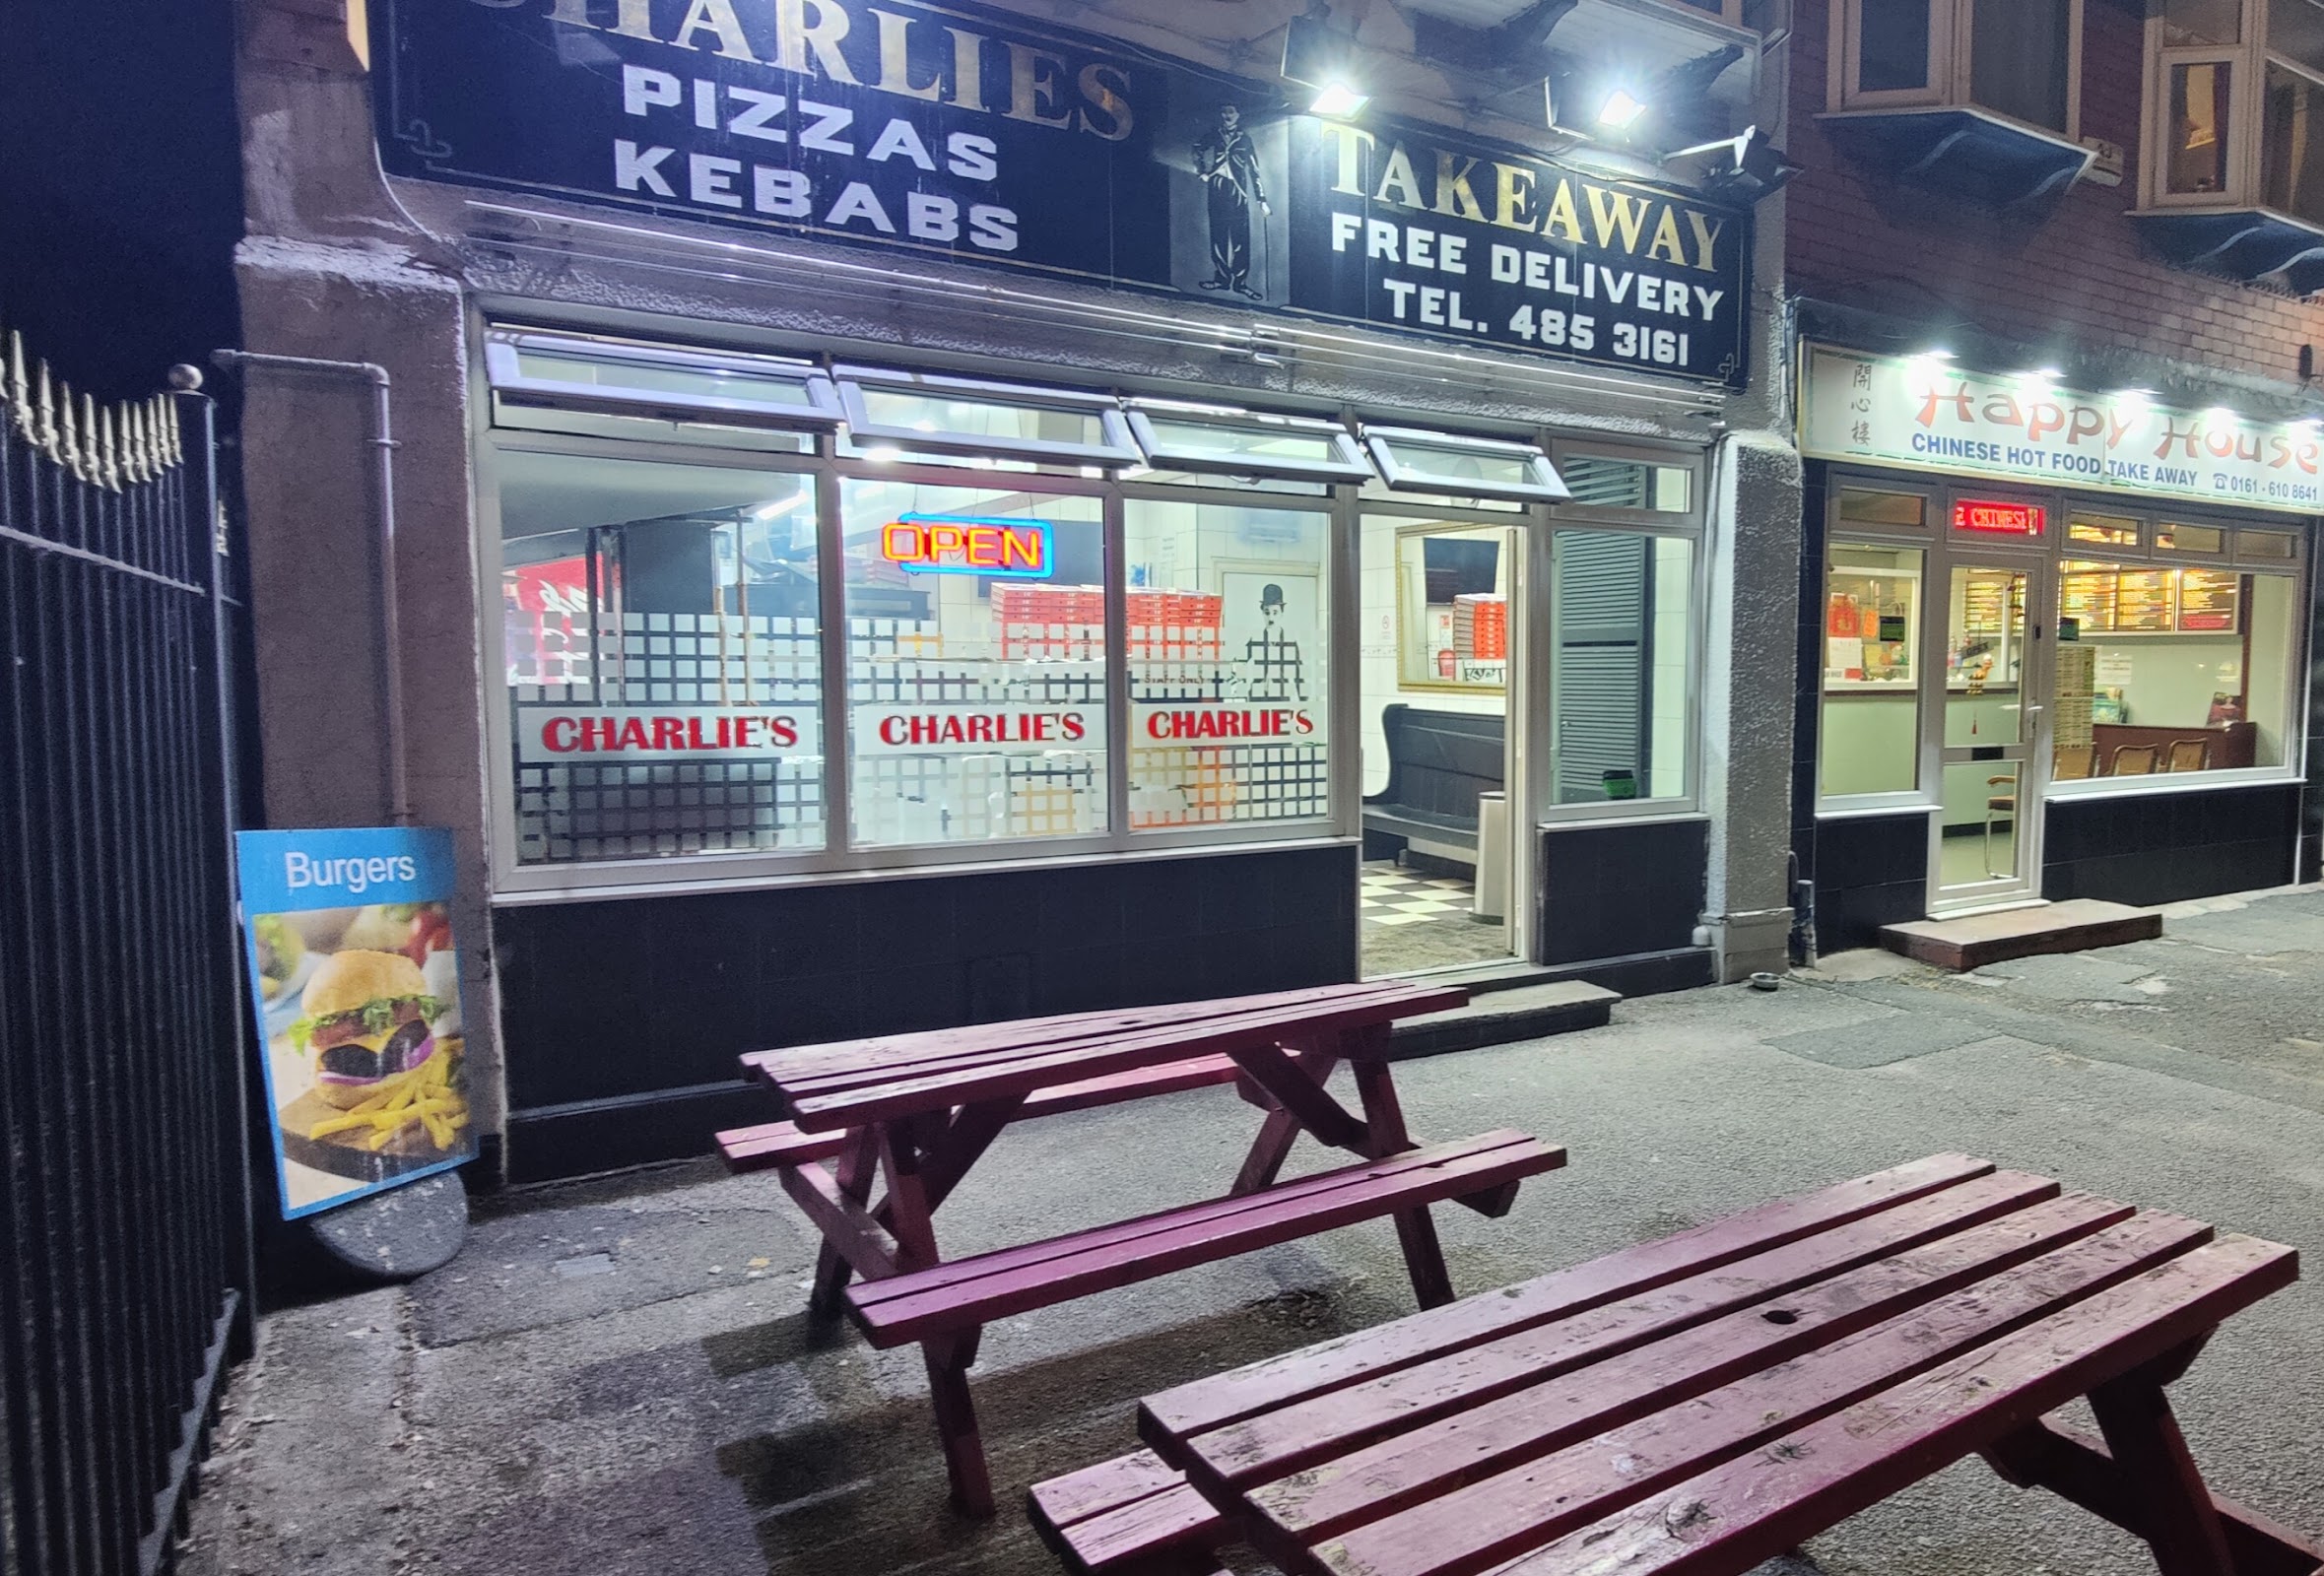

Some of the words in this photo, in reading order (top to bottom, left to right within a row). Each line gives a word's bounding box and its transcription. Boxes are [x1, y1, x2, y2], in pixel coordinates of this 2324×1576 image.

[470, 0, 1135, 140] ARLIES
[623, 63, 998, 183] PIZZAS
[615, 138, 1019, 252] KEBABS
[1320, 120, 1725, 273] TAKEAWAY
[1331, 211, 1468, 275] FREE
[1491, 243, 1724, 322] DELIVERY
[1383, 278, 1489, 334] TEL.
[1508, 303, 1595, 351] 485
[1612, 322, 1689, 366] 3161
[1911, 432, 2001, 462] CHINESE
[2007, 446, 2046, 468] HOT
[2052, 453, 2101, 474] FOOD
[2108, 459, 2150, 481] TAKE
[2155, 466, 2198, 487] AWAY
[2230, 476, 2258, 493] 0161
[2268, 482, 2289, 498] 610
[2292, 485, 2318, 500] 8641
[1915, 380, 2133, 450] Happy
[2154, 417, 2319, 475] House
[881, 521, 1040, 567] OPEN
[541, 714, 799, 754] CHARLIE'S
[878, 712, 1086, 746] CHARLIE'S
[1146, 708, 1314, 740] CHARLIE'S
[285, 851, 417, 894] Burgers
